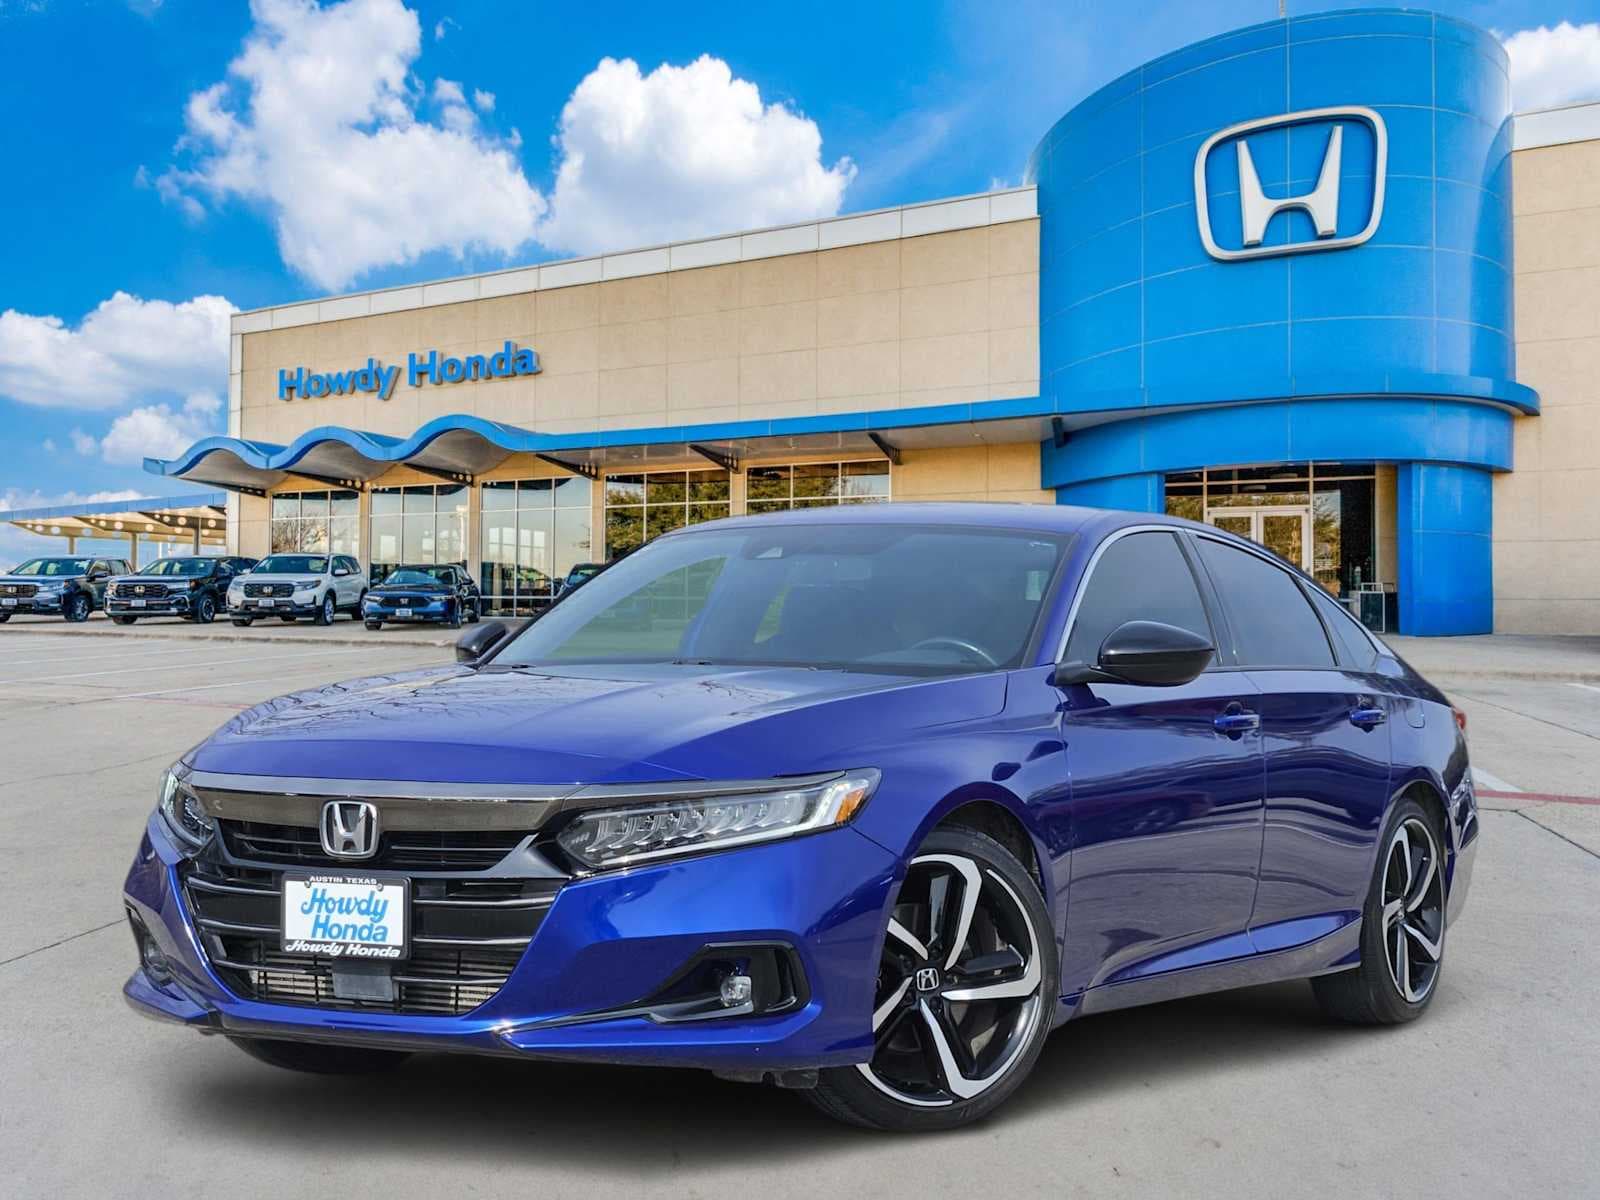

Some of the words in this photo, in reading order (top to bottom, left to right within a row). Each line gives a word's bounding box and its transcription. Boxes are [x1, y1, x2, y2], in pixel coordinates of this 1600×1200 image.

[278, 358, 401, 401] Howdy
[408, 340, 541, 387] Honda
[346, 877, 377, 885] TEXAS
[300, 888, 389, 923] Howdy
[311, 914, 389, 942] Honda
[285, 940, 345, 956] Howdy
[345, 943, 401, 958] Honda
